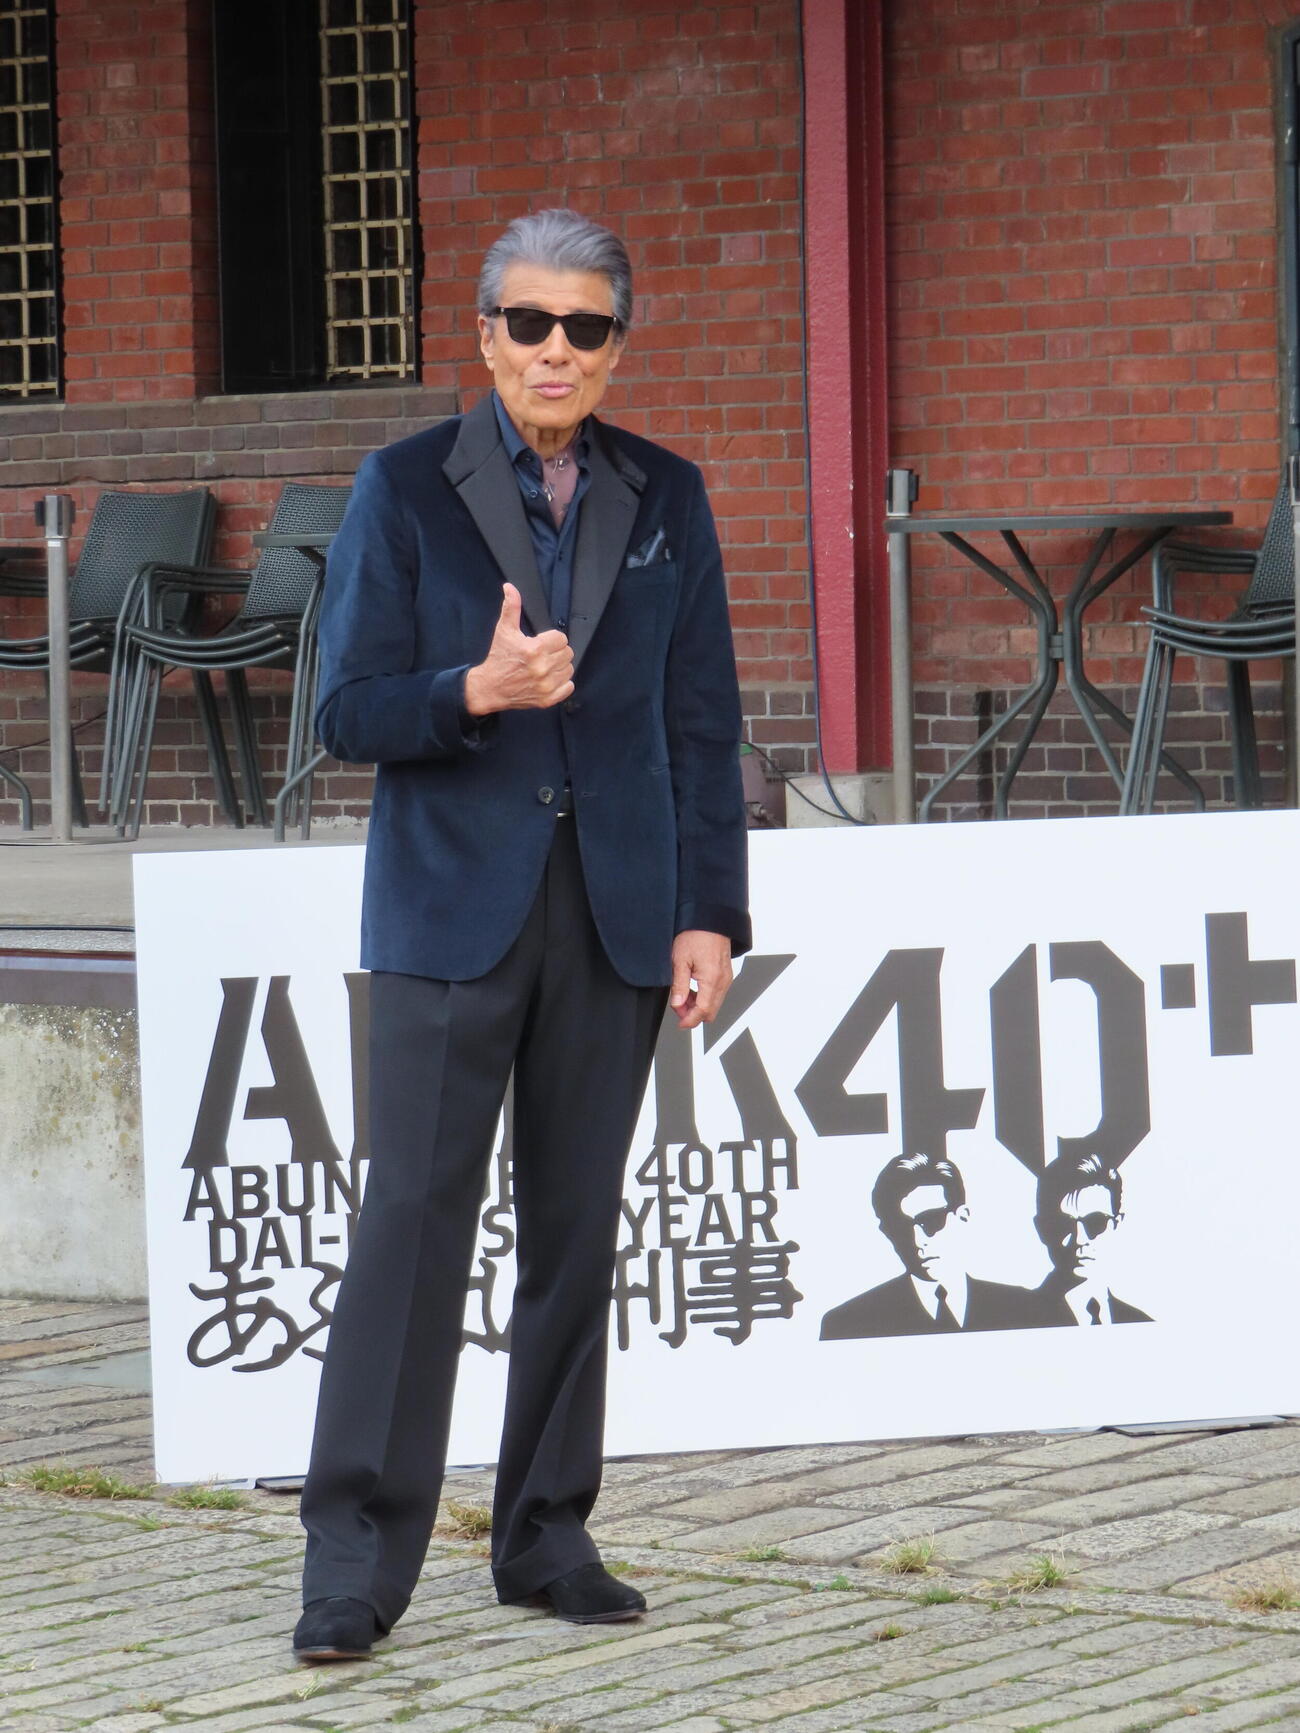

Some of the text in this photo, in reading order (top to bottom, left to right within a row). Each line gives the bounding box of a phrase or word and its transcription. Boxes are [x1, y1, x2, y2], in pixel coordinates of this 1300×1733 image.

[182, 1137, 800, 1222] ABUN 40TH
[619, 1191, 780, 1250] YEAR
